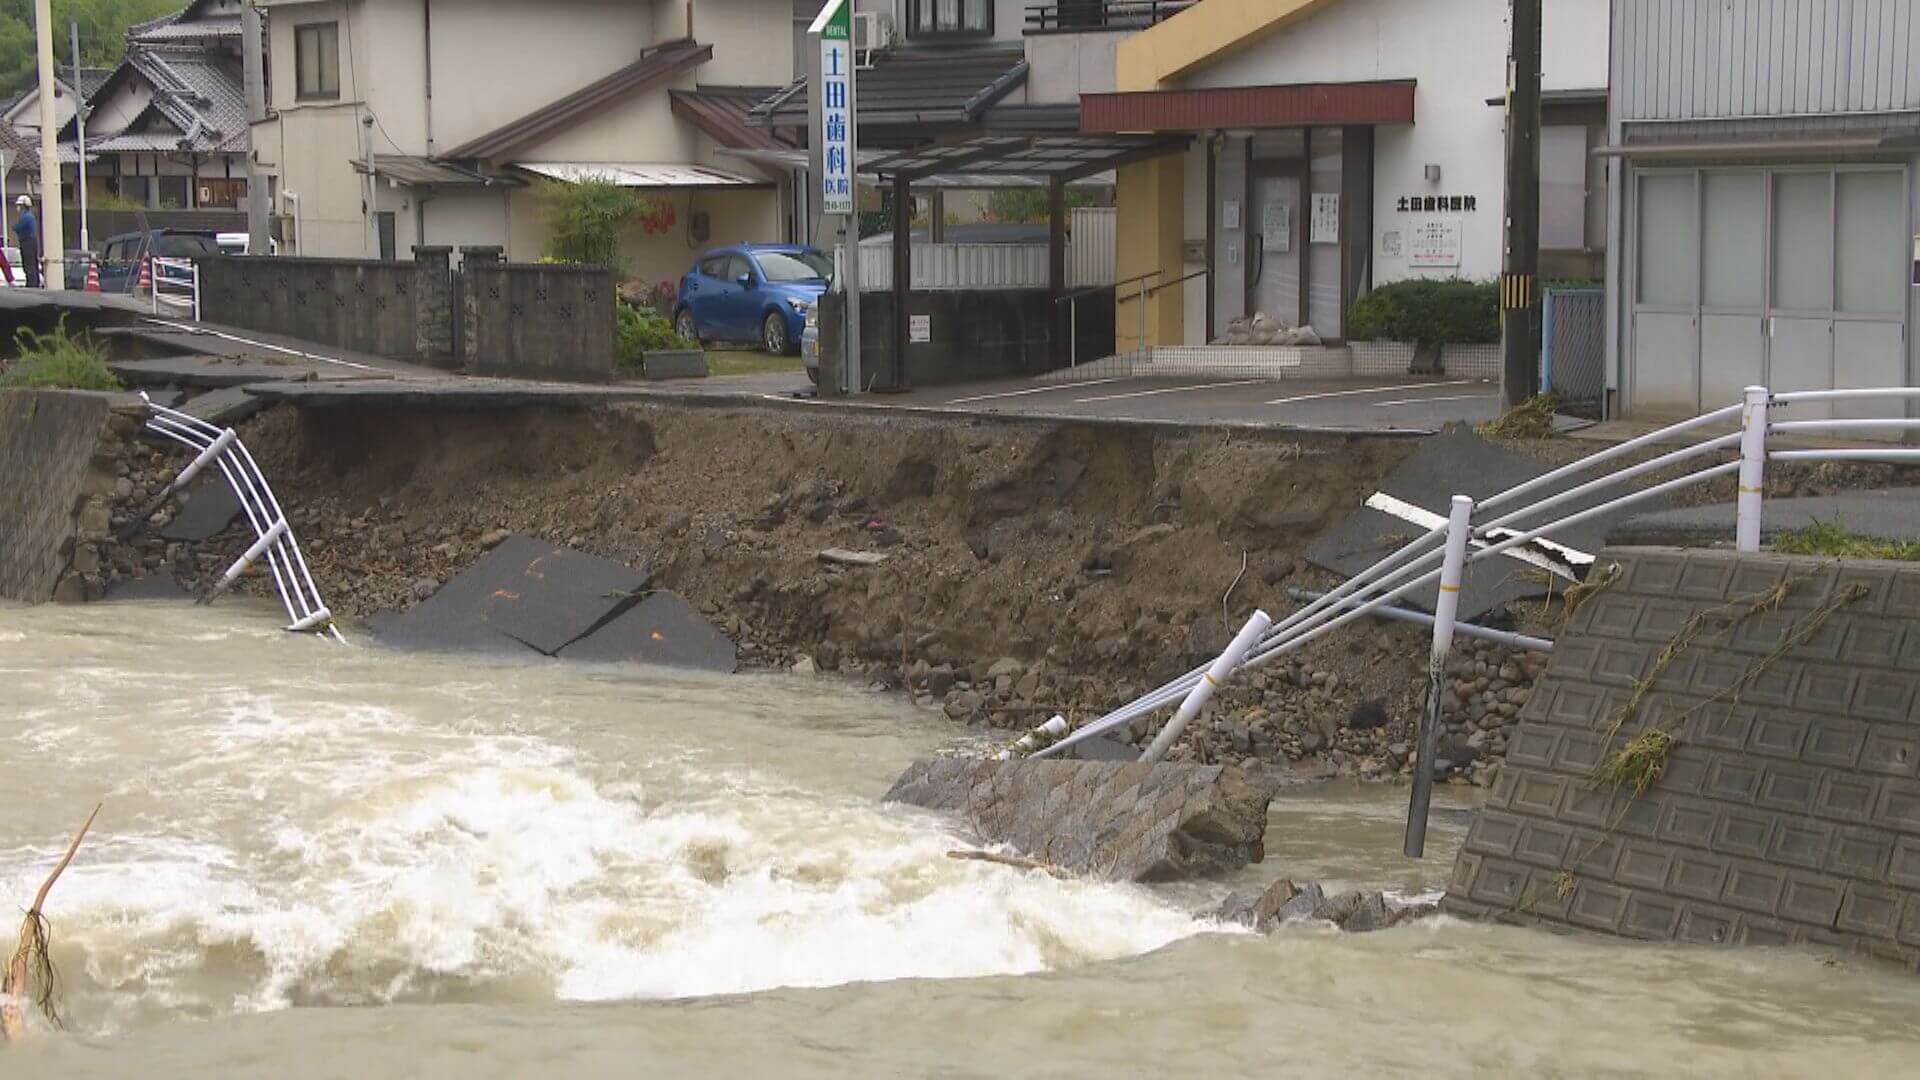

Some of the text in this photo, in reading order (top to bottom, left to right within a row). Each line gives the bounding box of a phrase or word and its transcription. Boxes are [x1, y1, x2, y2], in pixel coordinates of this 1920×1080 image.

[825, 24, 848, 37] DENTAL
[824, 47, 847, 175] 土田歯科
[1396, 194, 1477, 212] 土田歯科医院
